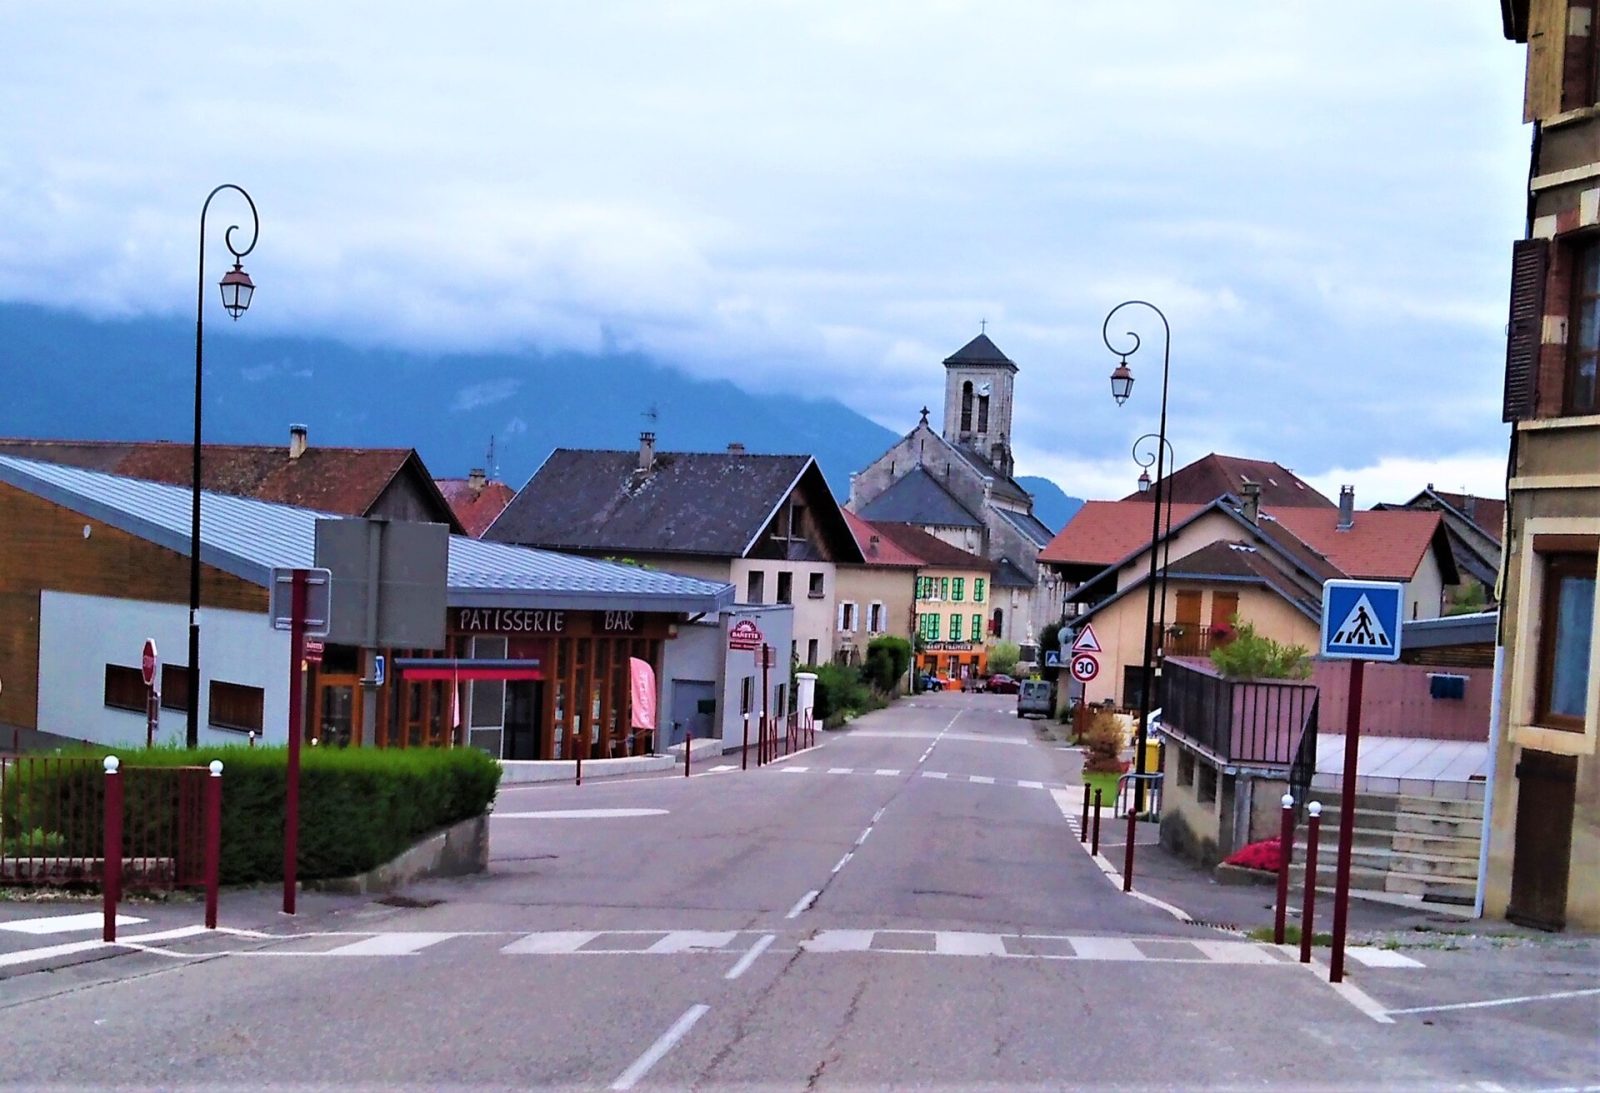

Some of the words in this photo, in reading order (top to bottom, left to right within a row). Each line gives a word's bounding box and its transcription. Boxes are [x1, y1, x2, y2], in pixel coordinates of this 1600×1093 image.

[460, 609, 565, 632] PATISSERIE
[605, 611, 634, 632] BAR
[1077, 661, 1094, 674] 30
